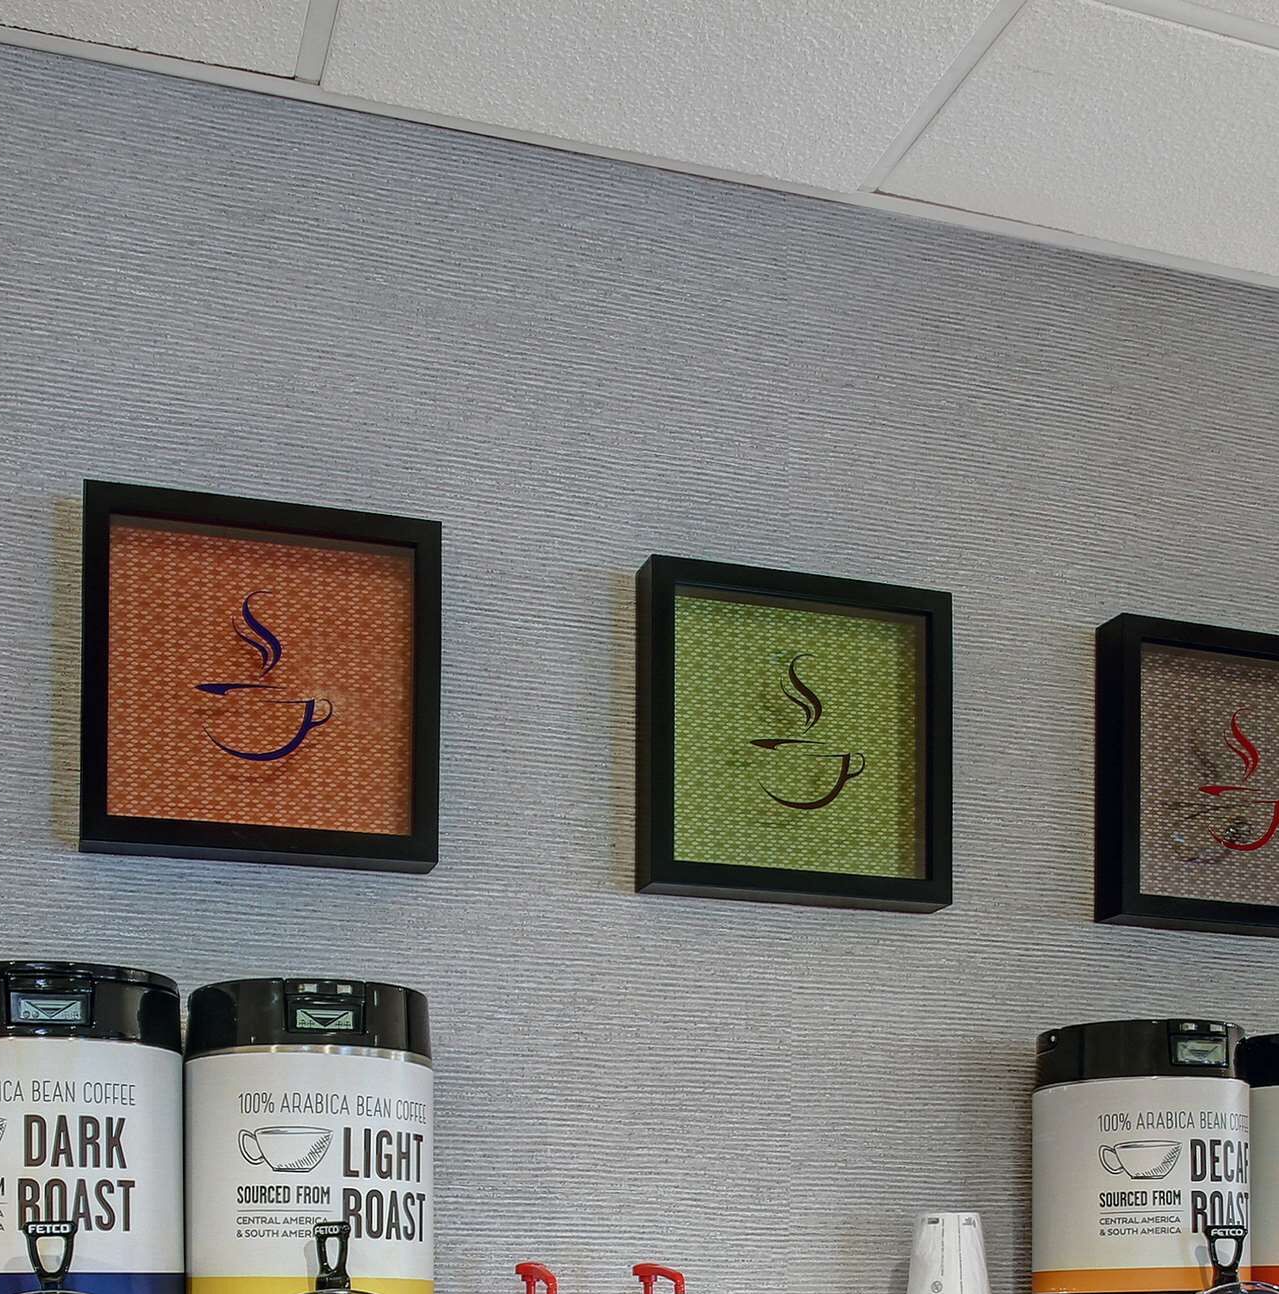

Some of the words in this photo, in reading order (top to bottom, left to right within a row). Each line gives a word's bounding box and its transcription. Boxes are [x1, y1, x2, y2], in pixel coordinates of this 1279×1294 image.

[32, 1080, 76, 1103] BEAN
[83, 1082, 136, 1106] COFFEE
[238, 1093, 274, 1114] 100%
[280, 1093, 350, 1115] ARABICA
[357, 1095, 391, 1118] BEAN
[396, 1100, 426, 1124] COFFEE
[1098, 1113, 1131, 1132] 100%
[1136, 1111, 1195, 1129] ARABICA
[1200, 1111, 1226, 1129] BEAN
[24, 1114, 127, 1169] DARK
[343, 1127, 424, 1183] LIGHT
[237, 1186, 290, 1204] SOURCED
[296, 1186, 330, 1204] FROM
[1099, 1191, 1147, 1207] SOURCED
[1153, 1190, 1181, 1206] FROM
[17, 1178, 135, 1232] ROAST
[236, 1216, 281, 1225] CENTRAL
[343, 1188, 426, 1242] ROAST
[1099, 1217, 1139, 1225] CENTRAL
[28, 1225, 70, 1234] FETCO
[236, 1230, 243, 1238] &
[245, 1229, 279, 1238] SOUTH
[315, 1226, 339, 1234] FETCO
[1141, 1226, 1182, 1234] AMERICA
[1211, 1229, 1243, 1237] FETCO
